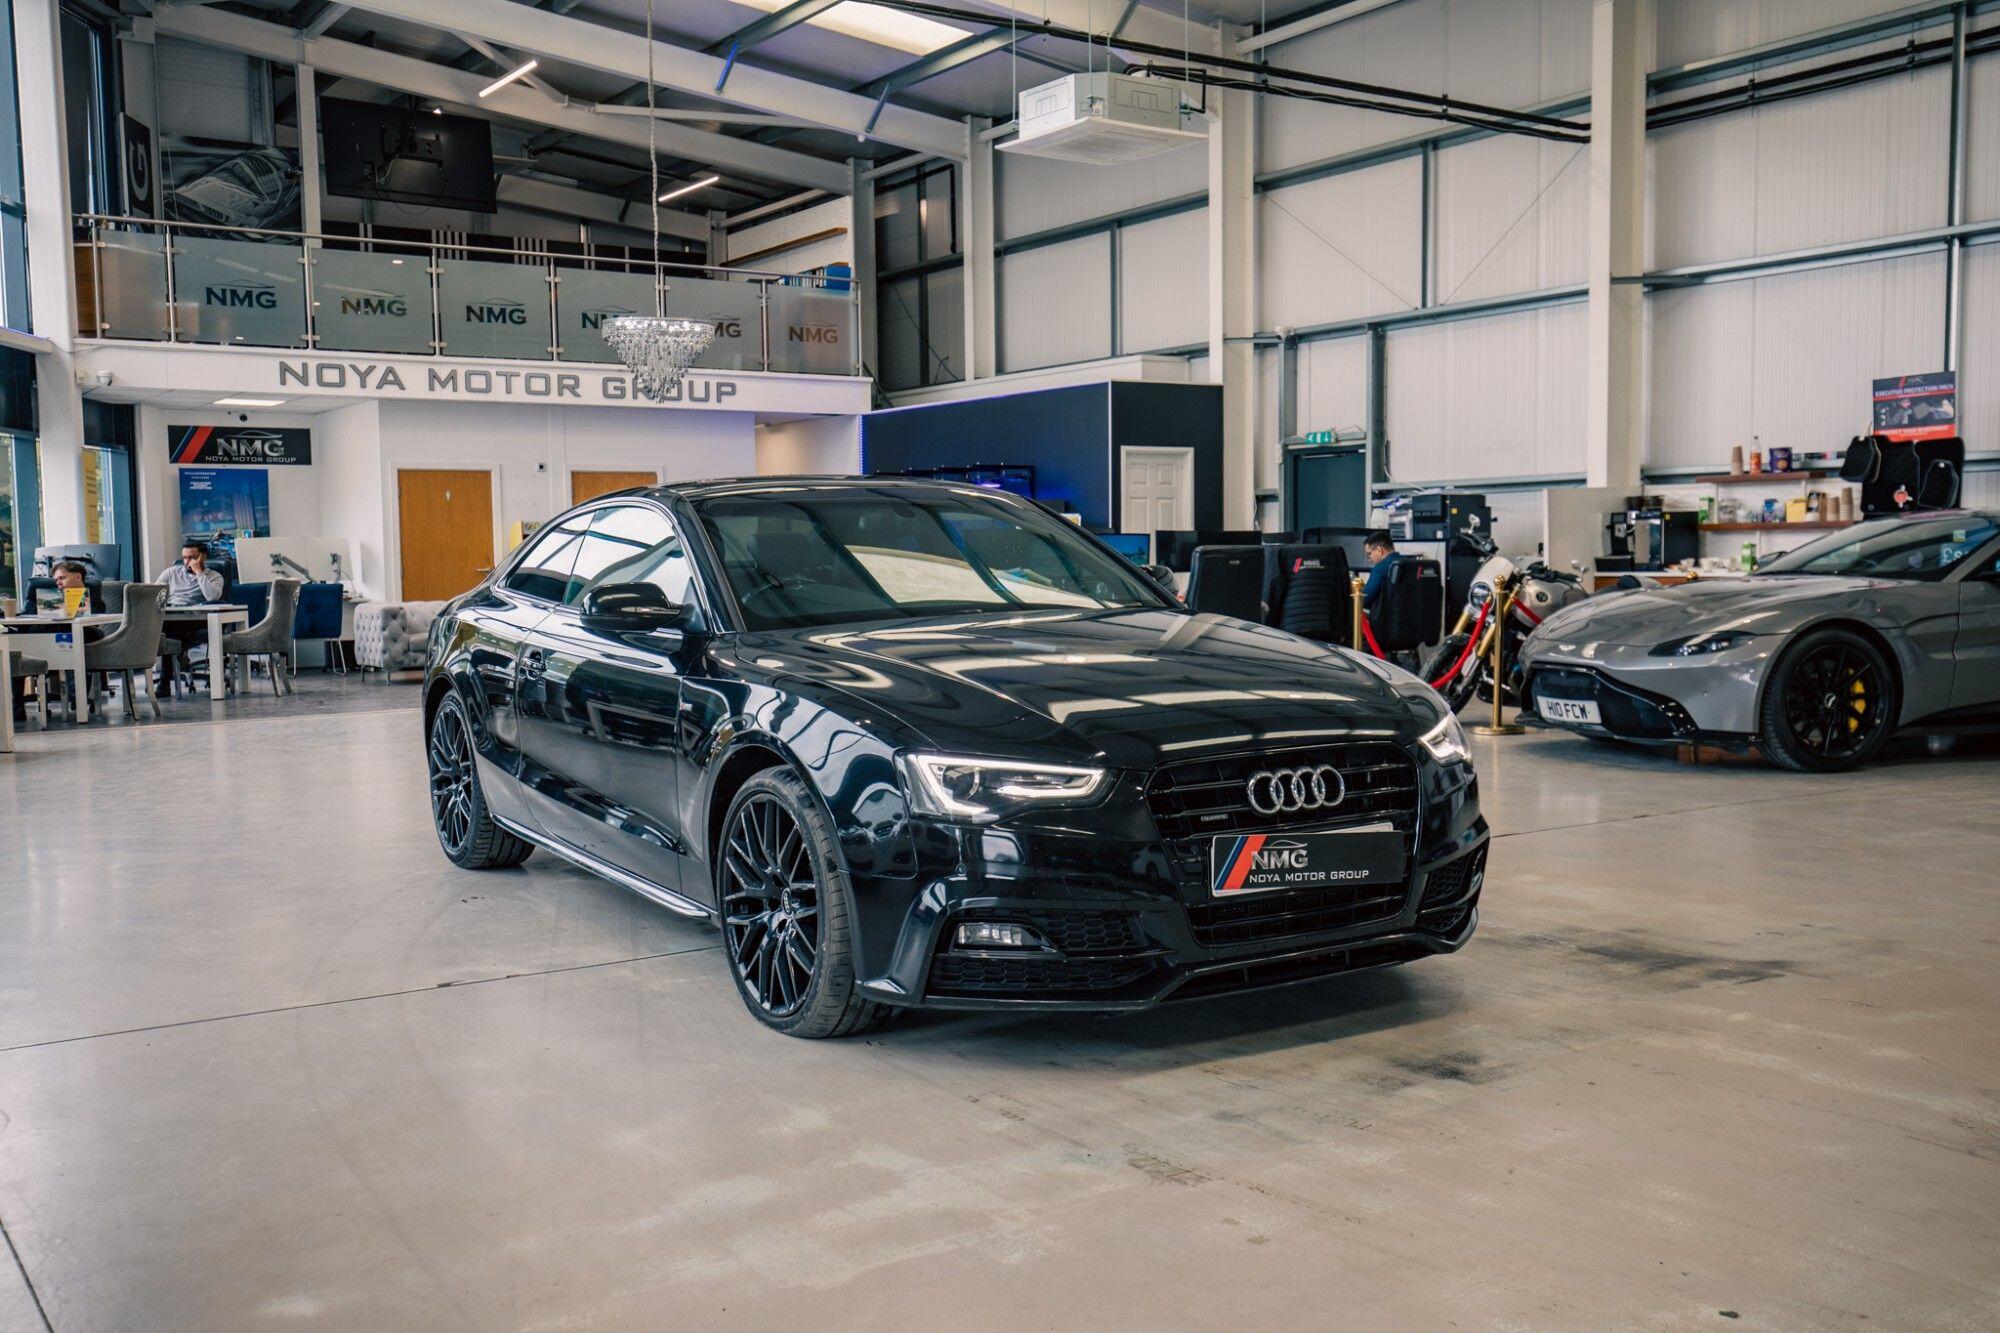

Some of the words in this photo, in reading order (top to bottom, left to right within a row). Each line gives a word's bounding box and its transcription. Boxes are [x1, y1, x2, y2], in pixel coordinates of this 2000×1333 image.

[205, 287, 277, 309] NMG
[341, 296, 407, 317] NMG
[466, 305, 527, 325] NMG
[714, 321, 742, 338] MG
[789, 325, 839, 344] NMG
[279, 361, 405, 390] NOYA
[428, 367, 581, 398] MOTOR
[217, 438, 285, 457] NMG
[1250, 849, 1309, 870] NMG
[1249, 873, 1281, 883] NOYA
[1285, 871, 1326, 882] MOTOR
[1330, 869, 1370, 880] GROUP
